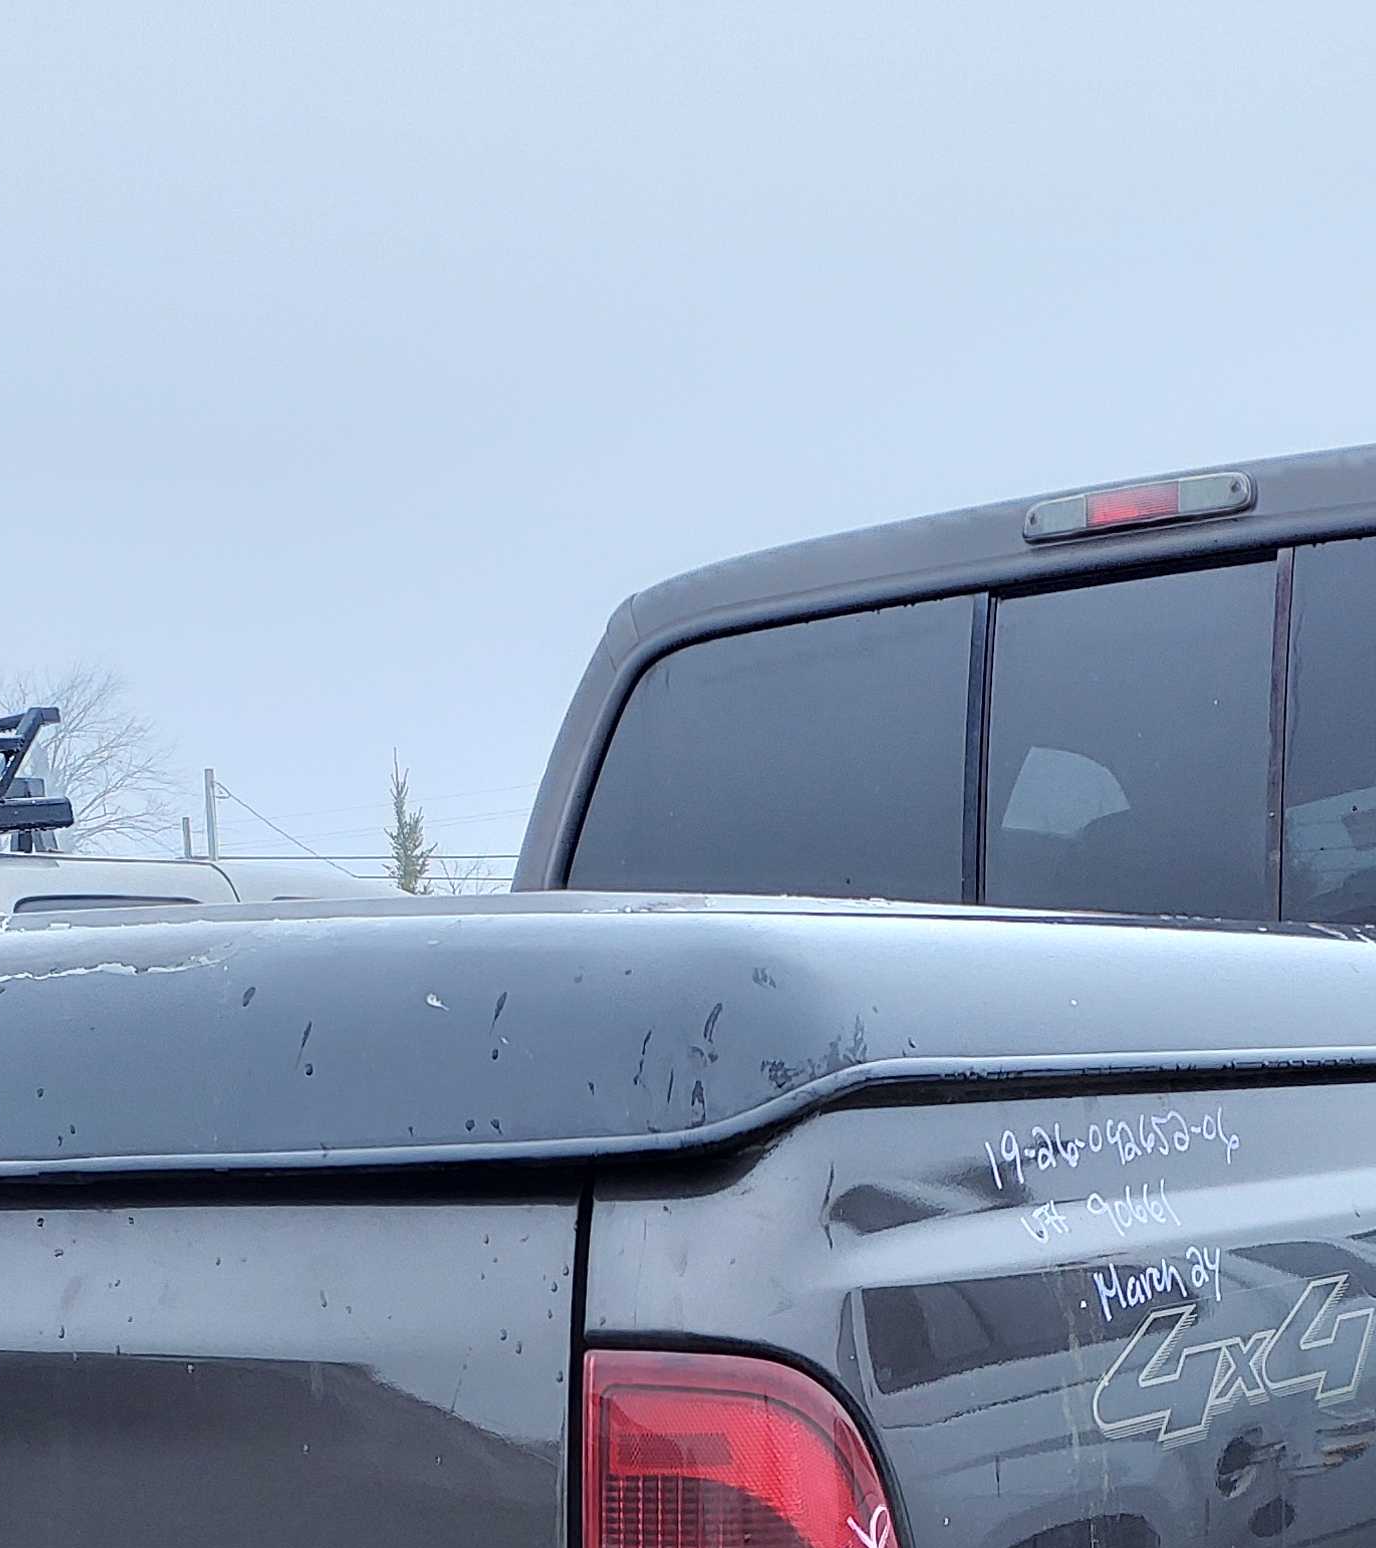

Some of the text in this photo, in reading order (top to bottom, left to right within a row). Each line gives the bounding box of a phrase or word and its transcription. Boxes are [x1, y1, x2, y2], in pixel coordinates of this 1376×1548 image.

[1087, 1177, 1182, 1237] 90661
[1093, 1245, 1222, 1322] March 24
[1093, 1271, 1376, 1452] 4x4
